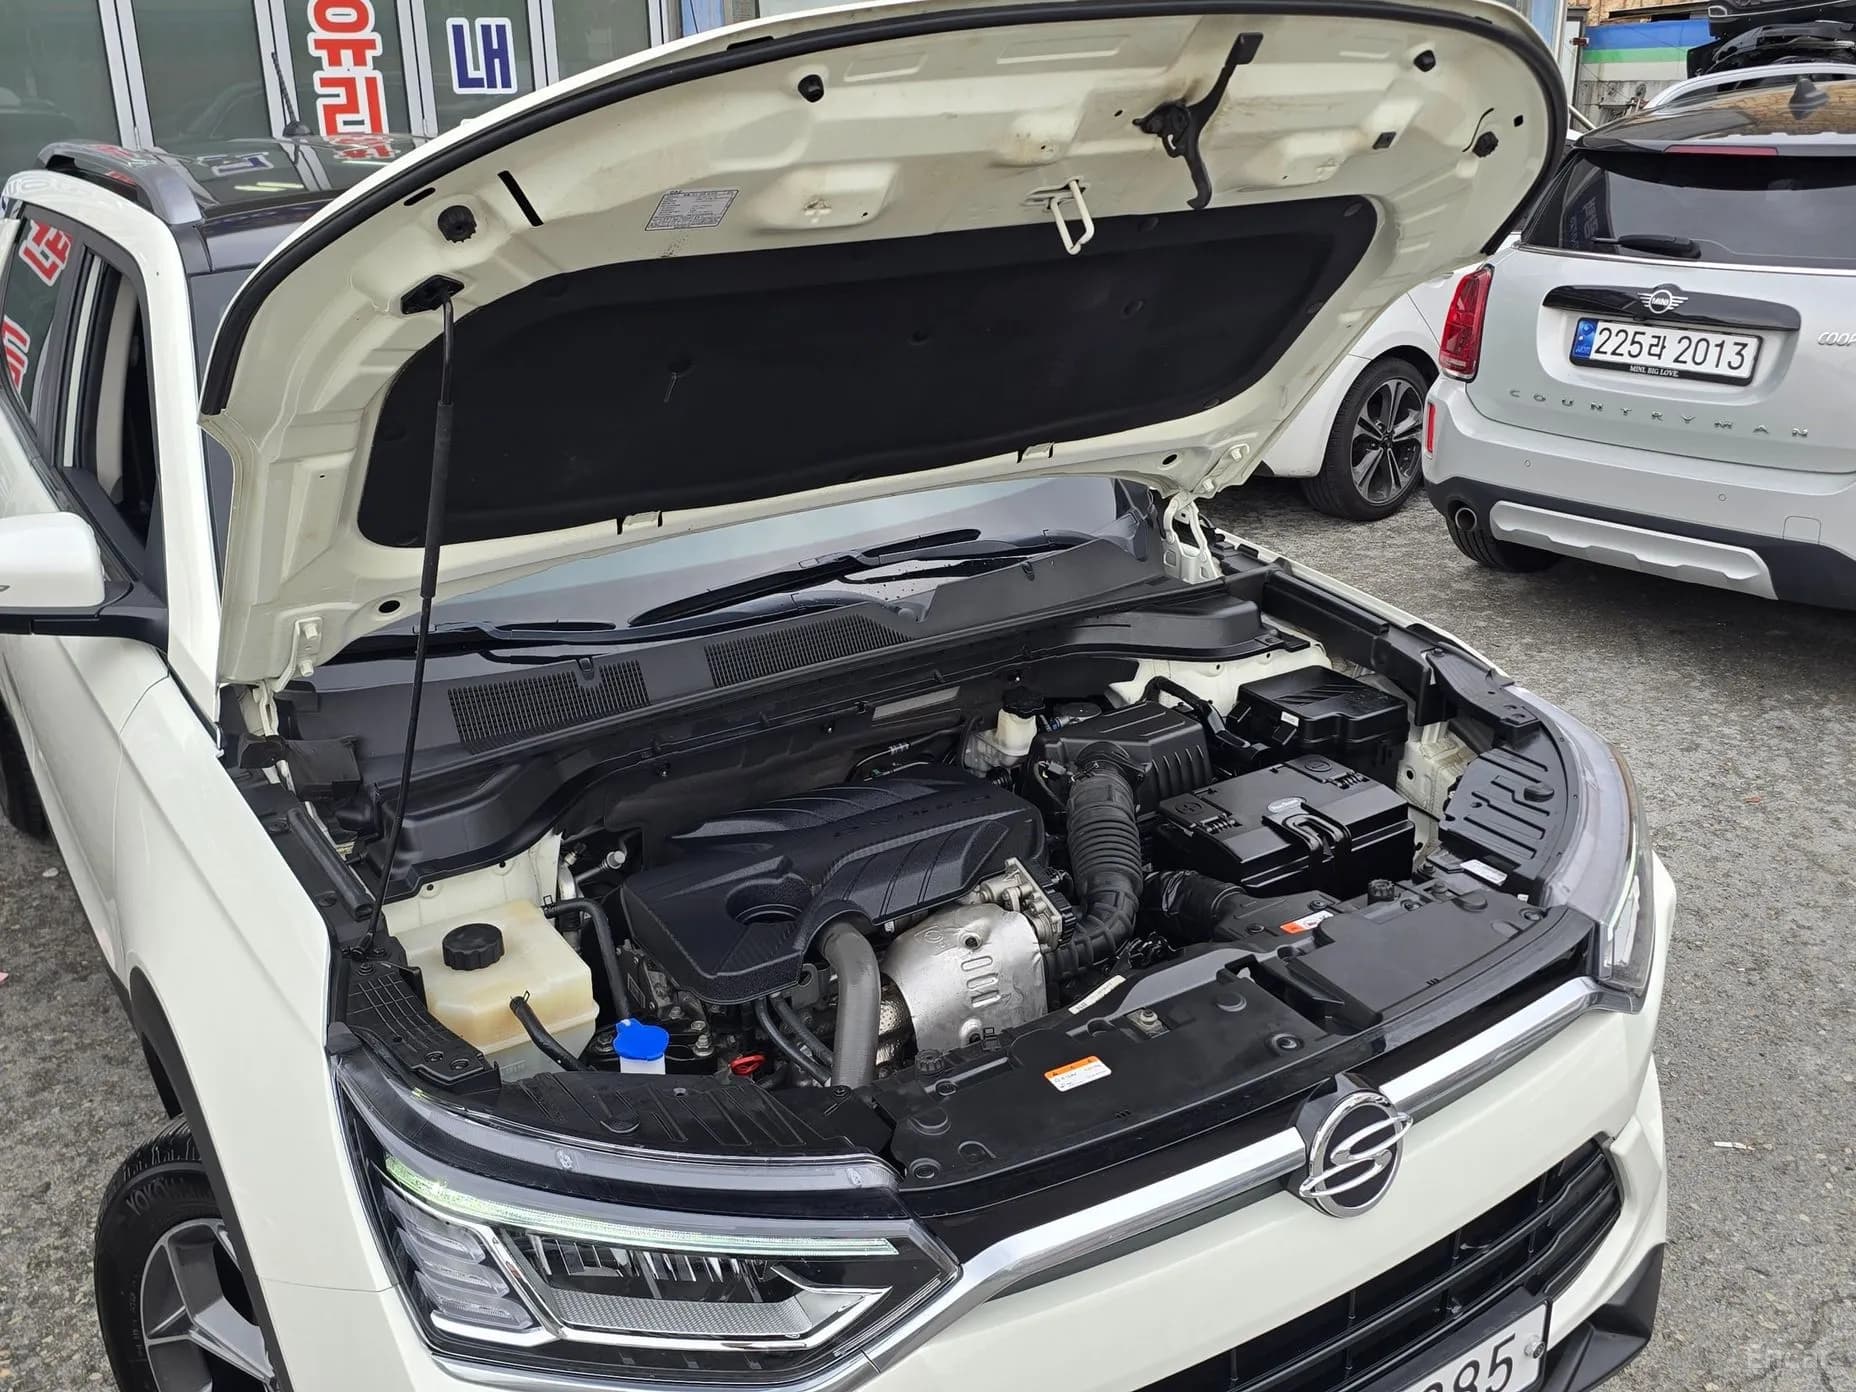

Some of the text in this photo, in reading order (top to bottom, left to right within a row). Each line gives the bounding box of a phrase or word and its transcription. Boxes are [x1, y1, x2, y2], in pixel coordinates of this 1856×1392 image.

[1652, 296, 1670, 306] MINI
[1595, 327, 1749, 371] 225라 2013
[1509, 389, 1808, 438] COUNTRYMAN
[1422, 1333, 1516, 1392] 85
